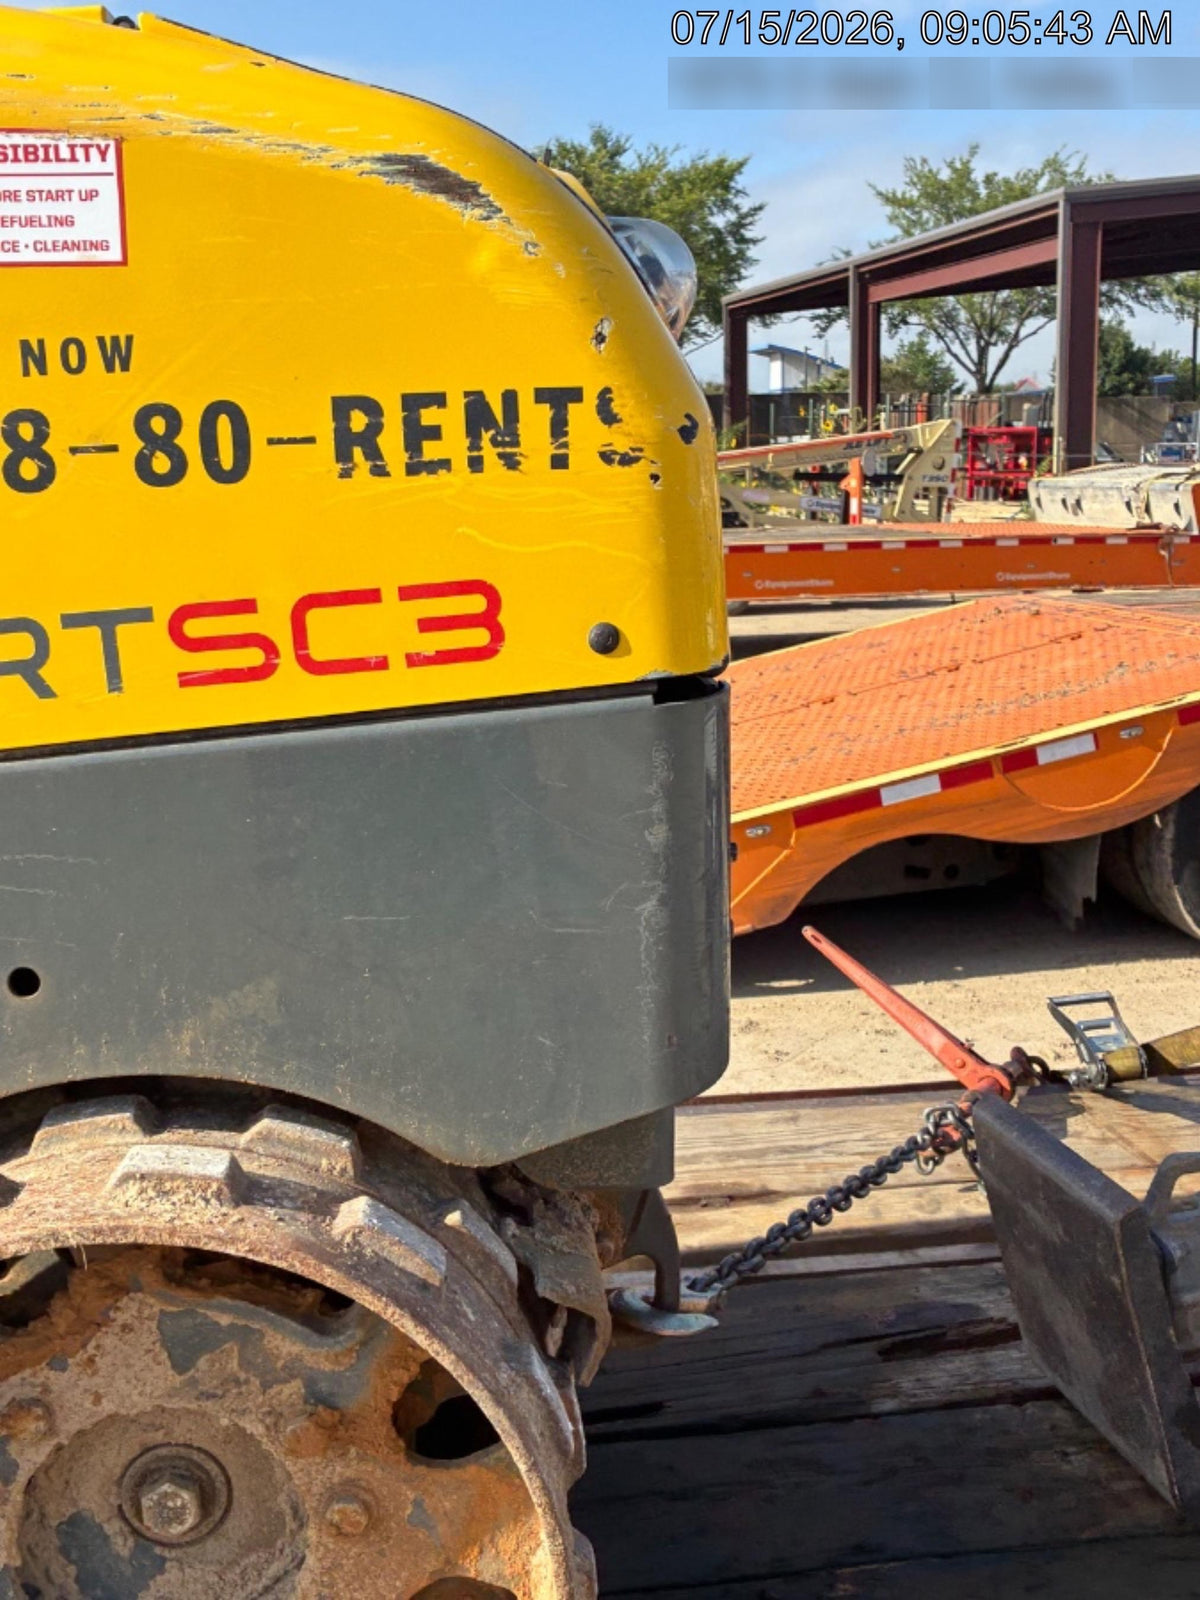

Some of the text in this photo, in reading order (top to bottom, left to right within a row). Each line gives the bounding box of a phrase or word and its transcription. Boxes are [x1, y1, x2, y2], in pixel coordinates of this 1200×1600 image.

[26, 190, 74, 202] START
[78, 190, 99, 202] UP
[33, 240, 110, 253] CLEANING
[19, 334, 134, 377] NOW
